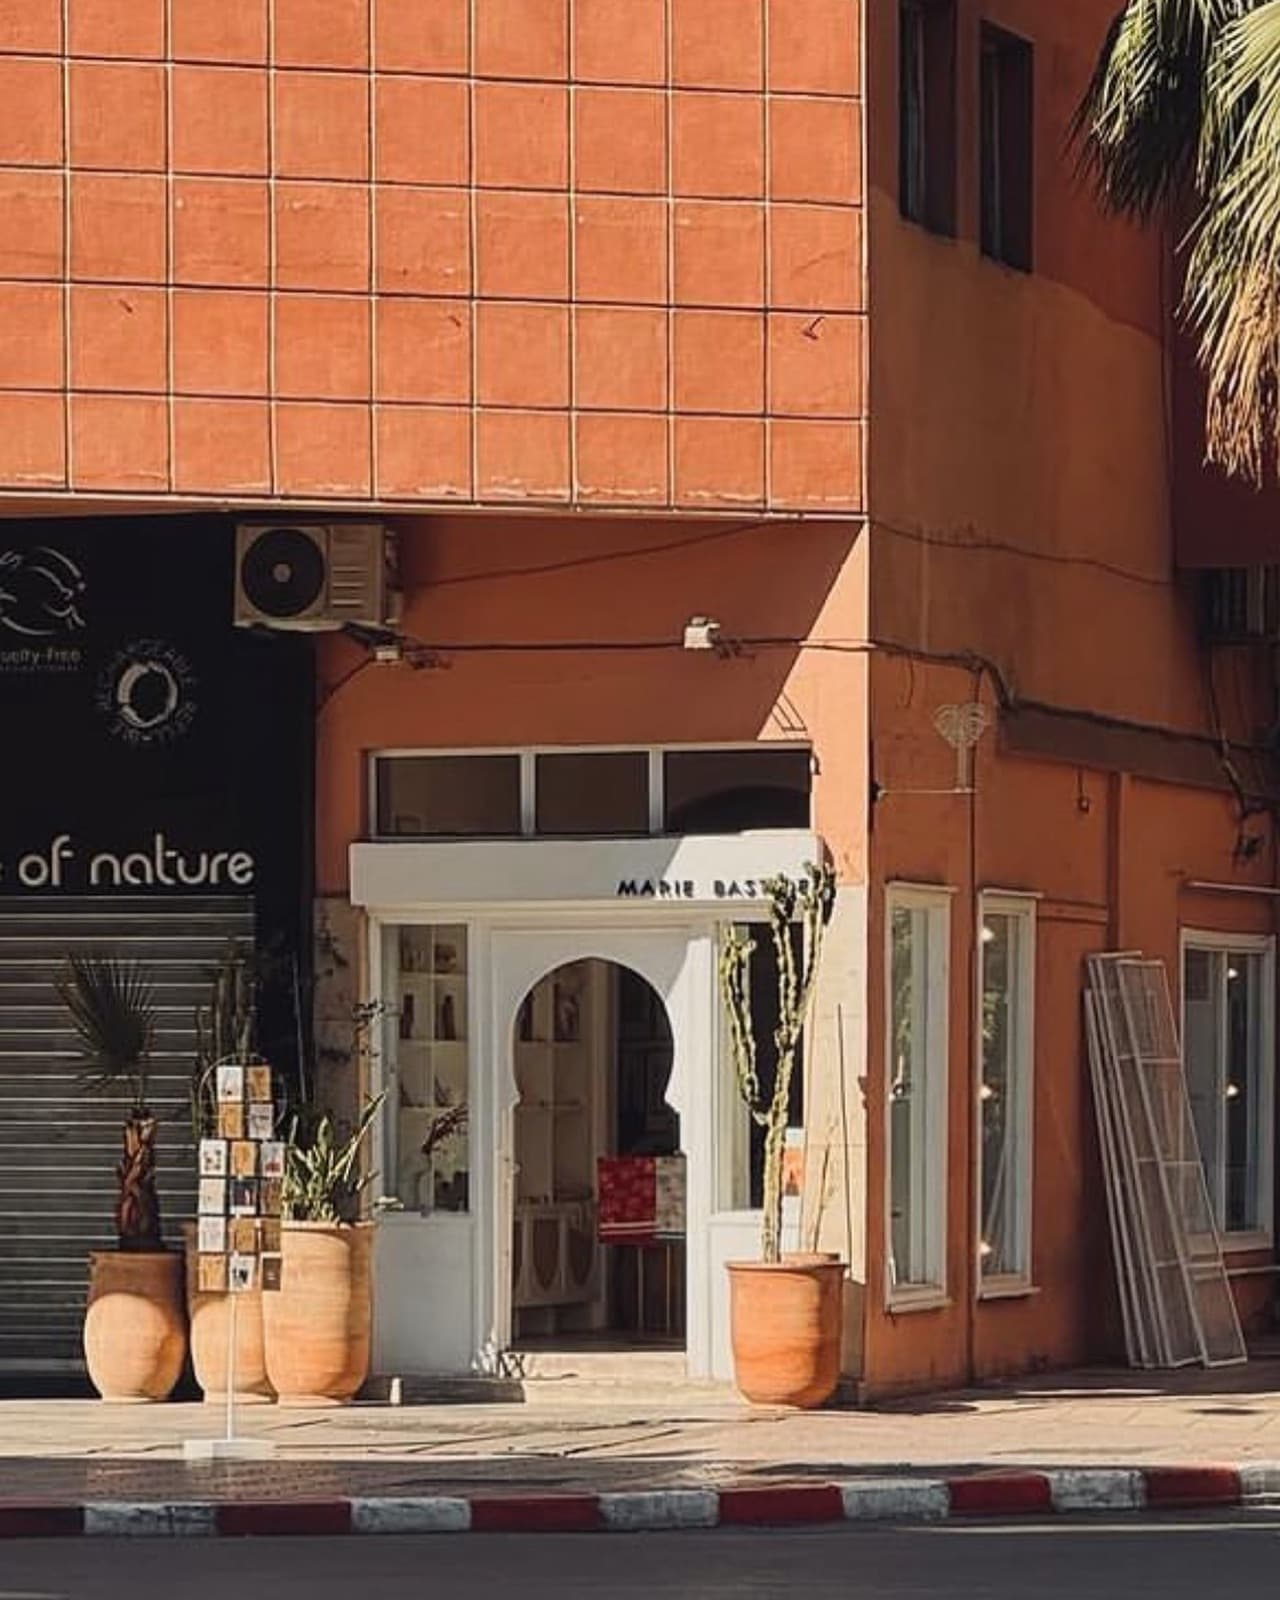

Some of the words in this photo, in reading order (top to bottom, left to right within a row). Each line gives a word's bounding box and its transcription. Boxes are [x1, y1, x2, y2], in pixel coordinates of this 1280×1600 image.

[18, 835, 73, 886] of
[90, 833, 254, 884] nature
[616, 880, 694, 897] MARIE
